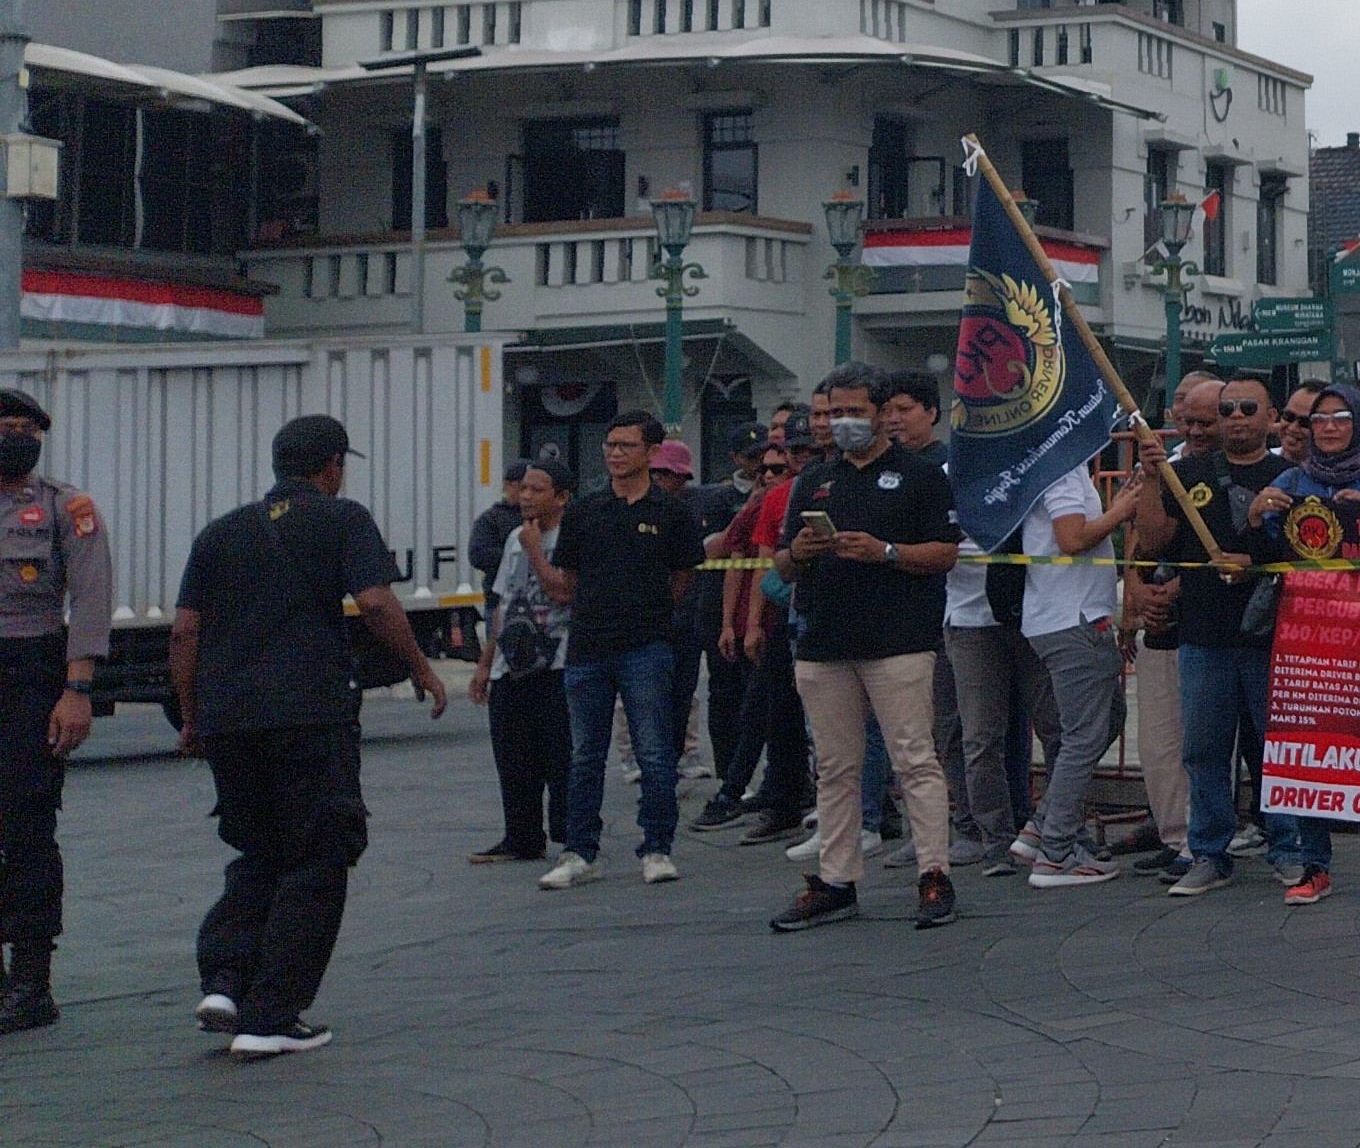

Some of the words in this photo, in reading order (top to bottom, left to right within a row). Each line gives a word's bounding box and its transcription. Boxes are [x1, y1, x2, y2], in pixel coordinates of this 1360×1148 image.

[1241, 338, 1270, 348] PASAR
[1271, 336, 1319, 346] KRANGGAN
[1285, 570, 1351, 592] SEGERA
[1275, 653, 1283, 663] 1.
[1284, 654, 1330, 666] TETAPKAN
[1331, 658, 1357, 669] TARIF
[1274, 665, 1319, 677] DITERIMA
[1320, 669, 1353, 681] DRIVER
[1273, 677, 1281, 687] 2.
[1283, 678, 1311, 689] TARIF
[1312, 680, 1341, 692] BATAS
[1272, 689, 1290, 699] PER
[1292, 691, 1306, 701] KM
[1307, 692, 1351, 705] DITERIMA
[1271, 701, 1280, 712] 3.
[1282, 702, 1331, 714] TURUNKAN
[1270, 713, 1297, 724] MAKS
[1298, 715, 1317, 726] 15%
[1270, 785, 1346, 813] DRIVER
